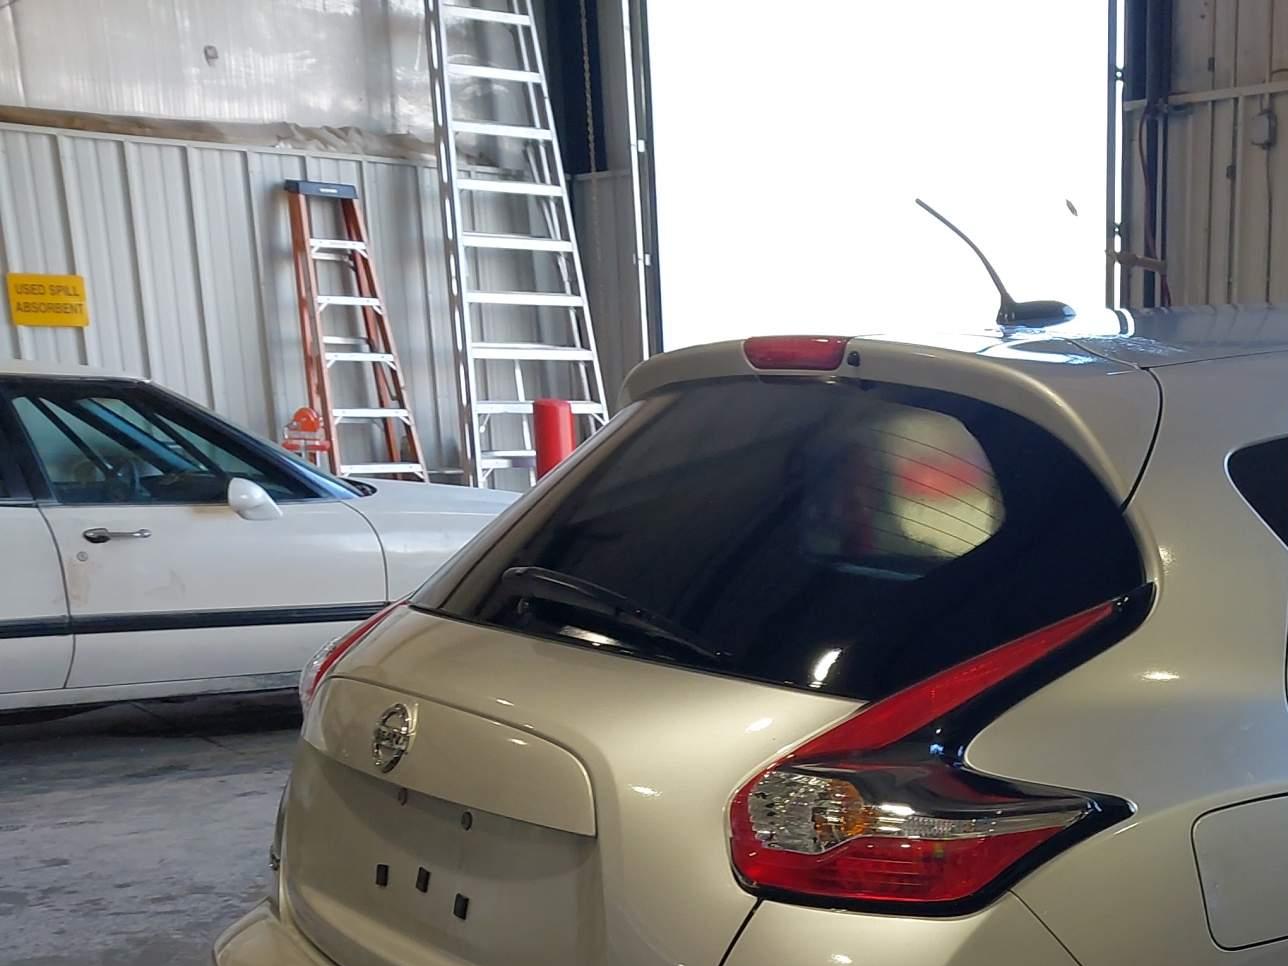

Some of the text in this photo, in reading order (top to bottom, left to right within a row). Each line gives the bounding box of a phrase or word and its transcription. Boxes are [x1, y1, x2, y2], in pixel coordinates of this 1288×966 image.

[16, 284, 80, 297] USED SPILL
[16, 301, 84, 314] ABSORBENT
